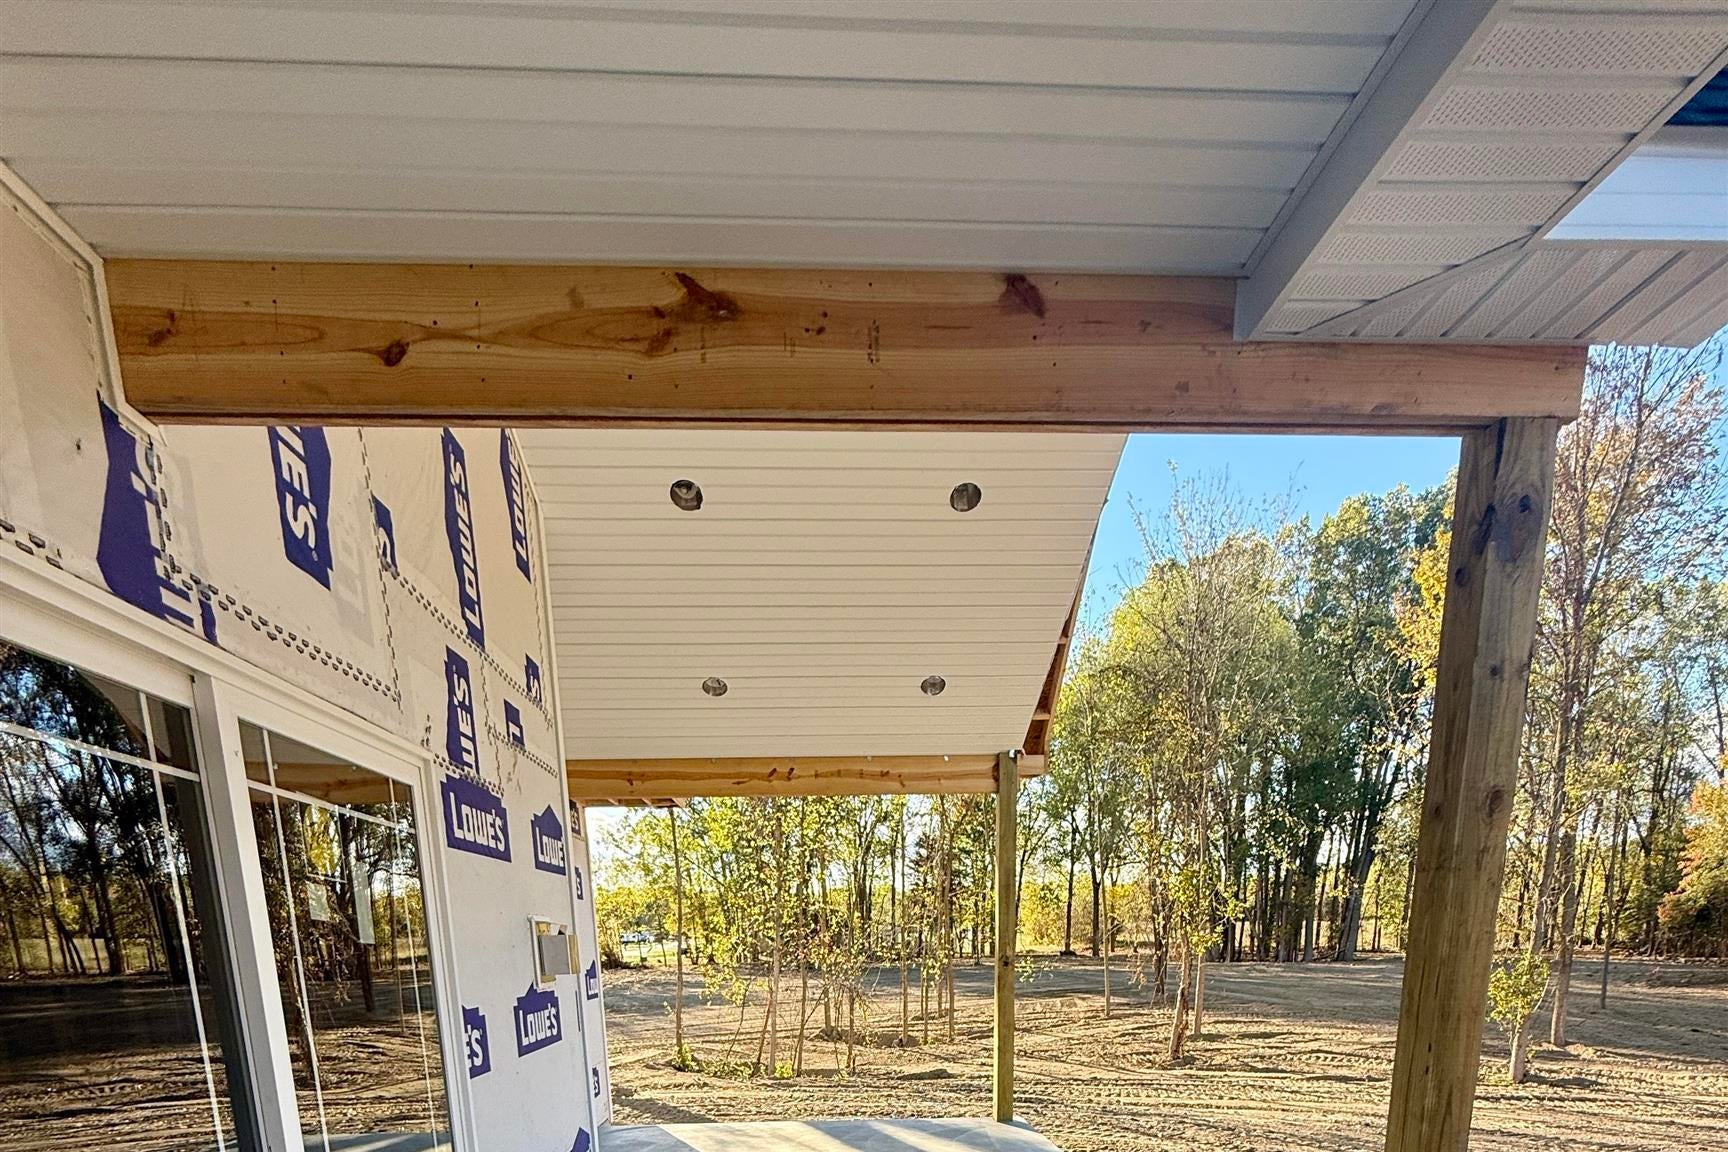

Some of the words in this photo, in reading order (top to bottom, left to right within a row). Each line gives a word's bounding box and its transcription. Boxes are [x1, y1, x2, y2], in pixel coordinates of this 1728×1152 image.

[450, 453, 481, 629] LOWE'S
[450, 792, 505, 852] LOWE'S
[519, 1003, 558, 1047] LOWE'S
